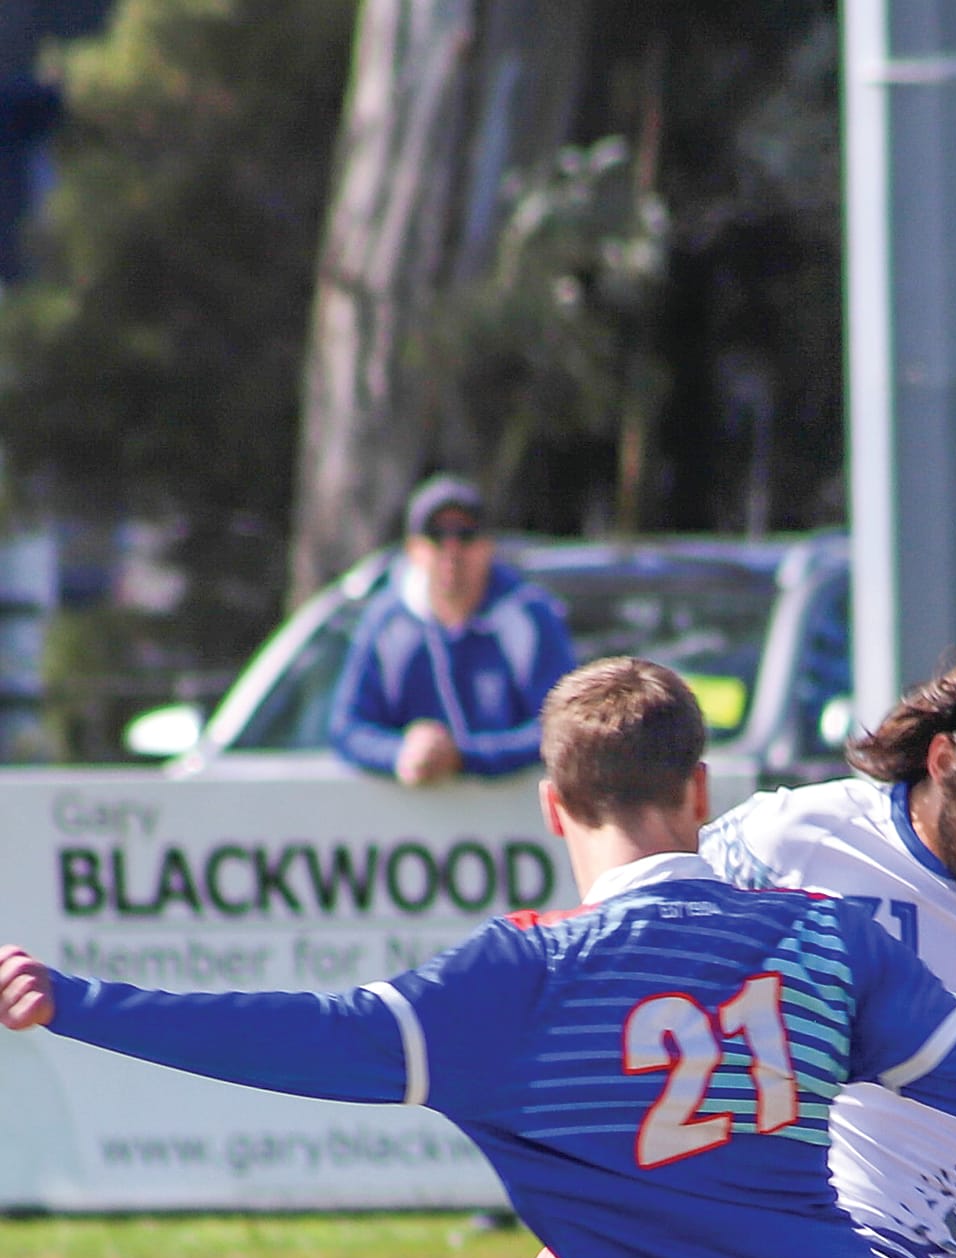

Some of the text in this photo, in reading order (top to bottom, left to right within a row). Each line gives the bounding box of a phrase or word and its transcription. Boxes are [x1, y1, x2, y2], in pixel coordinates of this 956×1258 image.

[55, 792, 158, 837] Gary
[60, 841, 556, 915] BLACKWOOD
[61, 938, 270, 982] Member
[293, 938, 364, 982] for
[622, 970, 799, 1170] 21
